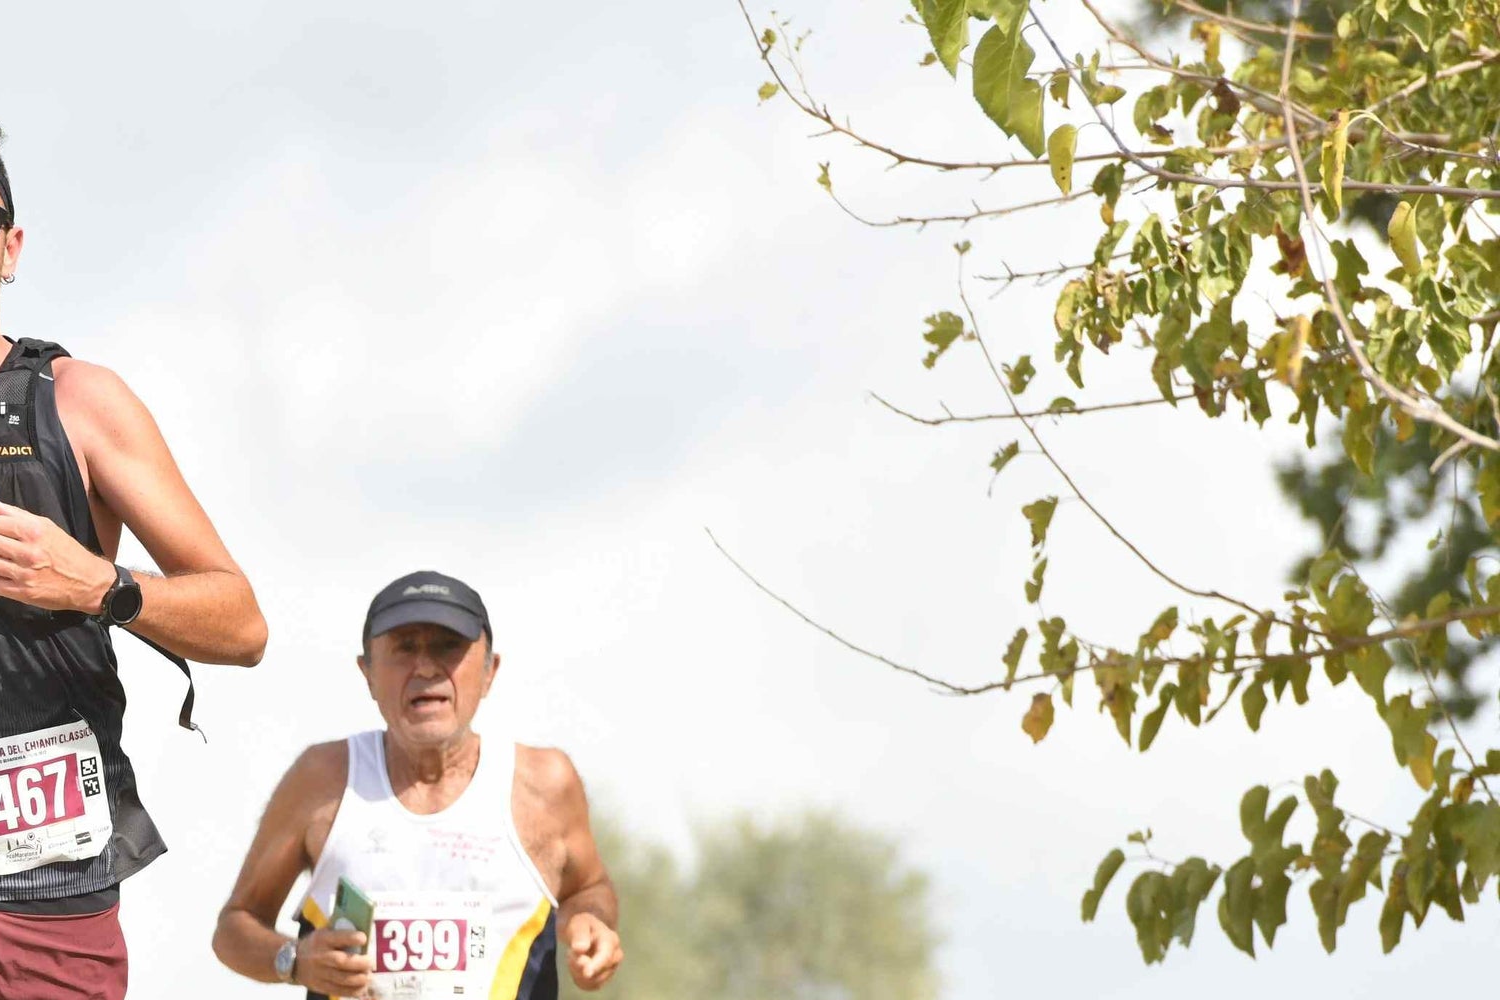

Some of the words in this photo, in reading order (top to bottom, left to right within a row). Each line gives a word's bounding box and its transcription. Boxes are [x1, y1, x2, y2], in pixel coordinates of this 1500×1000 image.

[8, 744, 23, 756] DEL
[24, 736, 57, 752] CHIANTI
[382, 919, 460, 972] 399
